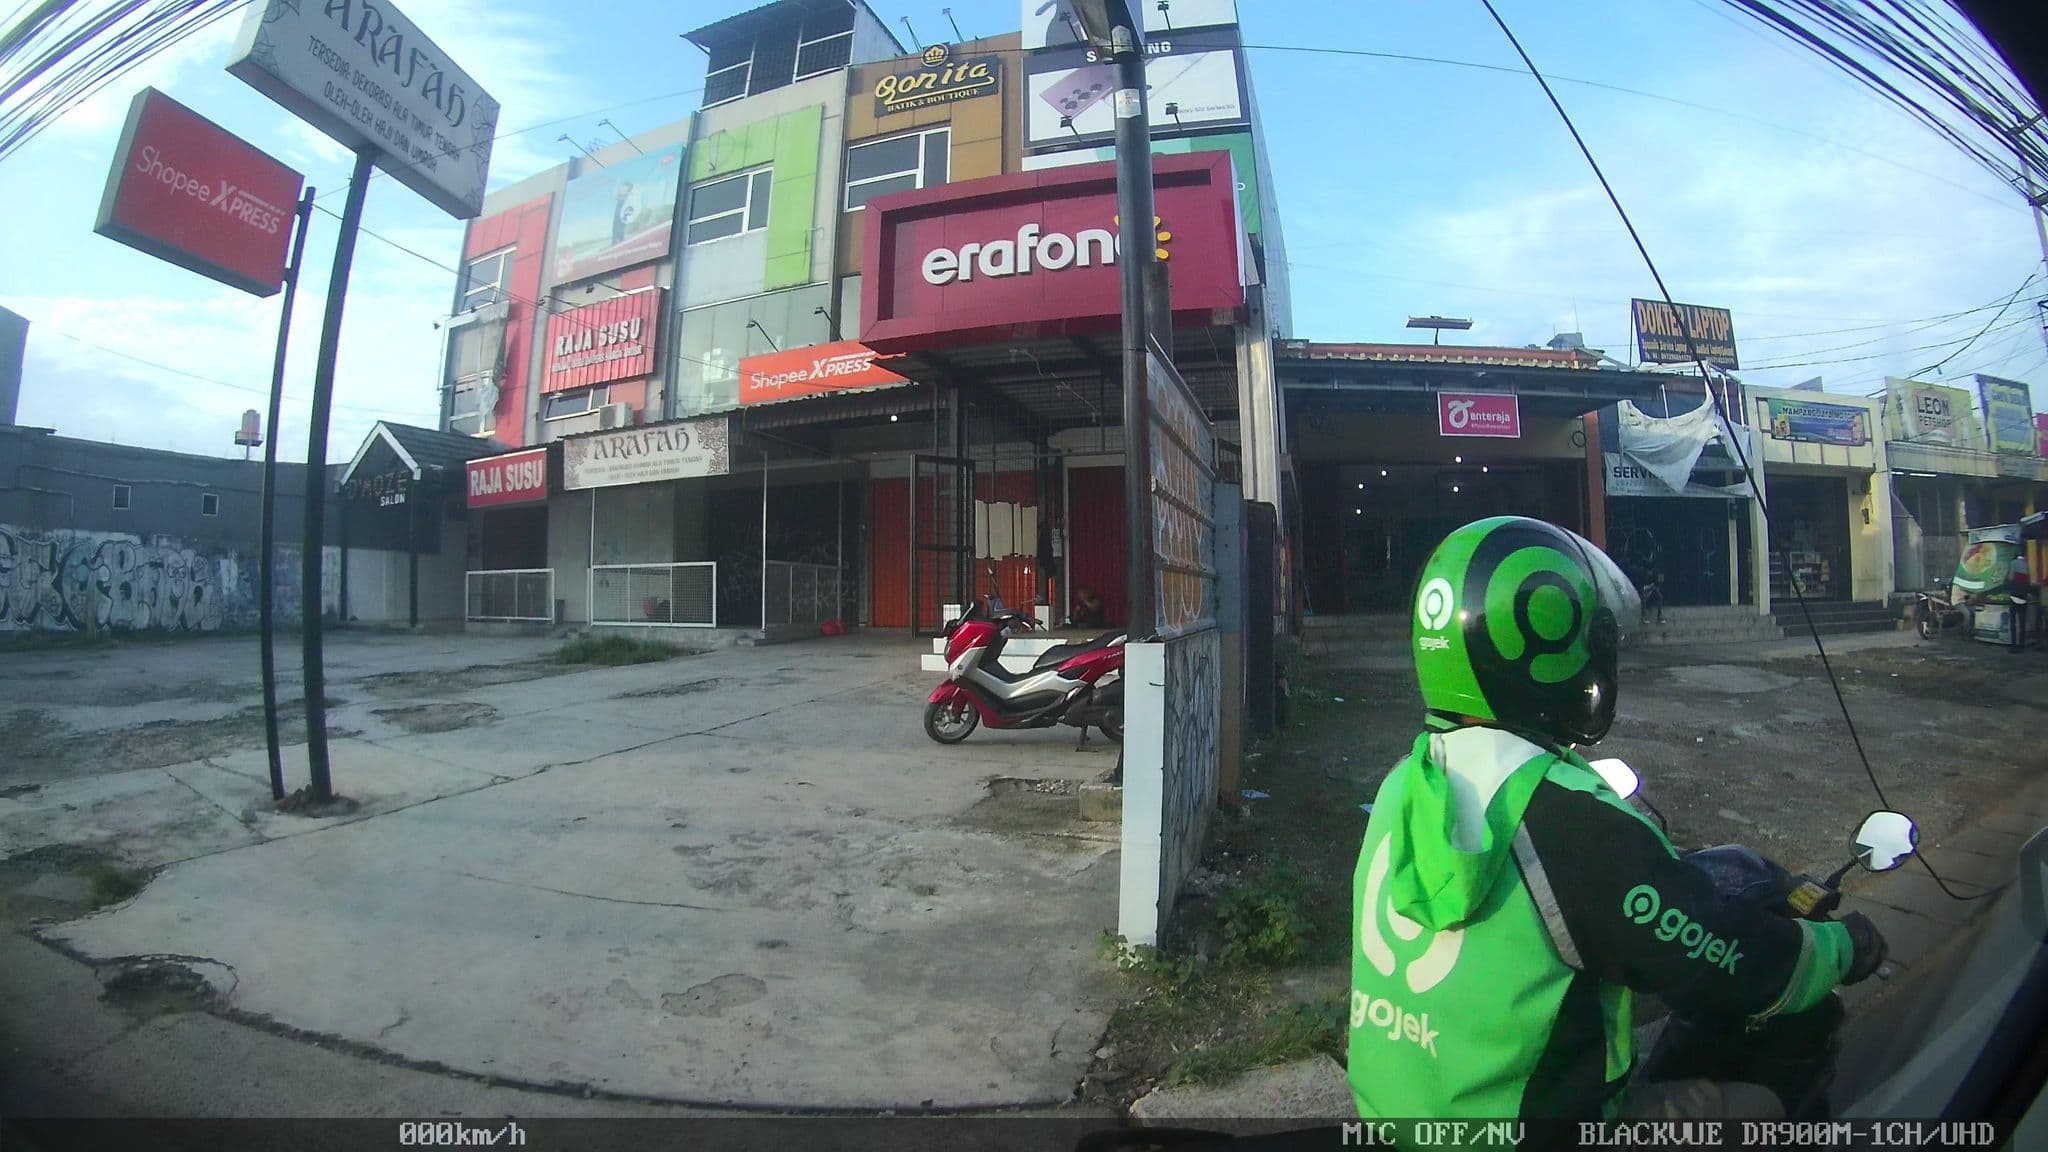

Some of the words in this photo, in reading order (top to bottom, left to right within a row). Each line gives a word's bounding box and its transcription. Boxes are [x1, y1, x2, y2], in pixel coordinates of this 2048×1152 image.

[352, 69, 393, 110] DEKORASI
[875, 62, 995, 105] Qonita
[136, 145, 211, 202] Shopee
[210, 180, 281, 235] XPRESS
[921, 223, 1121, 285] erafon
[555, 328, 593, 358] RAJA
[598, 317, 641, 347] SUSU
[1636, 301, 1684, 336] DOKTER
[1686, 306, 1730, 341] LAPTOP
[751, 370, 809, 392] Shopee
[808, 357, 873, 380] XPRESS
[1916, 396, 1951, 417] LEON
[594, 428, 690, 460] ARAFAH
[470, 469, 503, 497] RAJA
[506, 460, 544, 492] SUSU
[380, 494, 405, 507] SALON
[1419, 635, 1450, 651] gojek
[1654, 908, 1744, 976] gojek
[1351, 990, 1440, 1058] gojek
